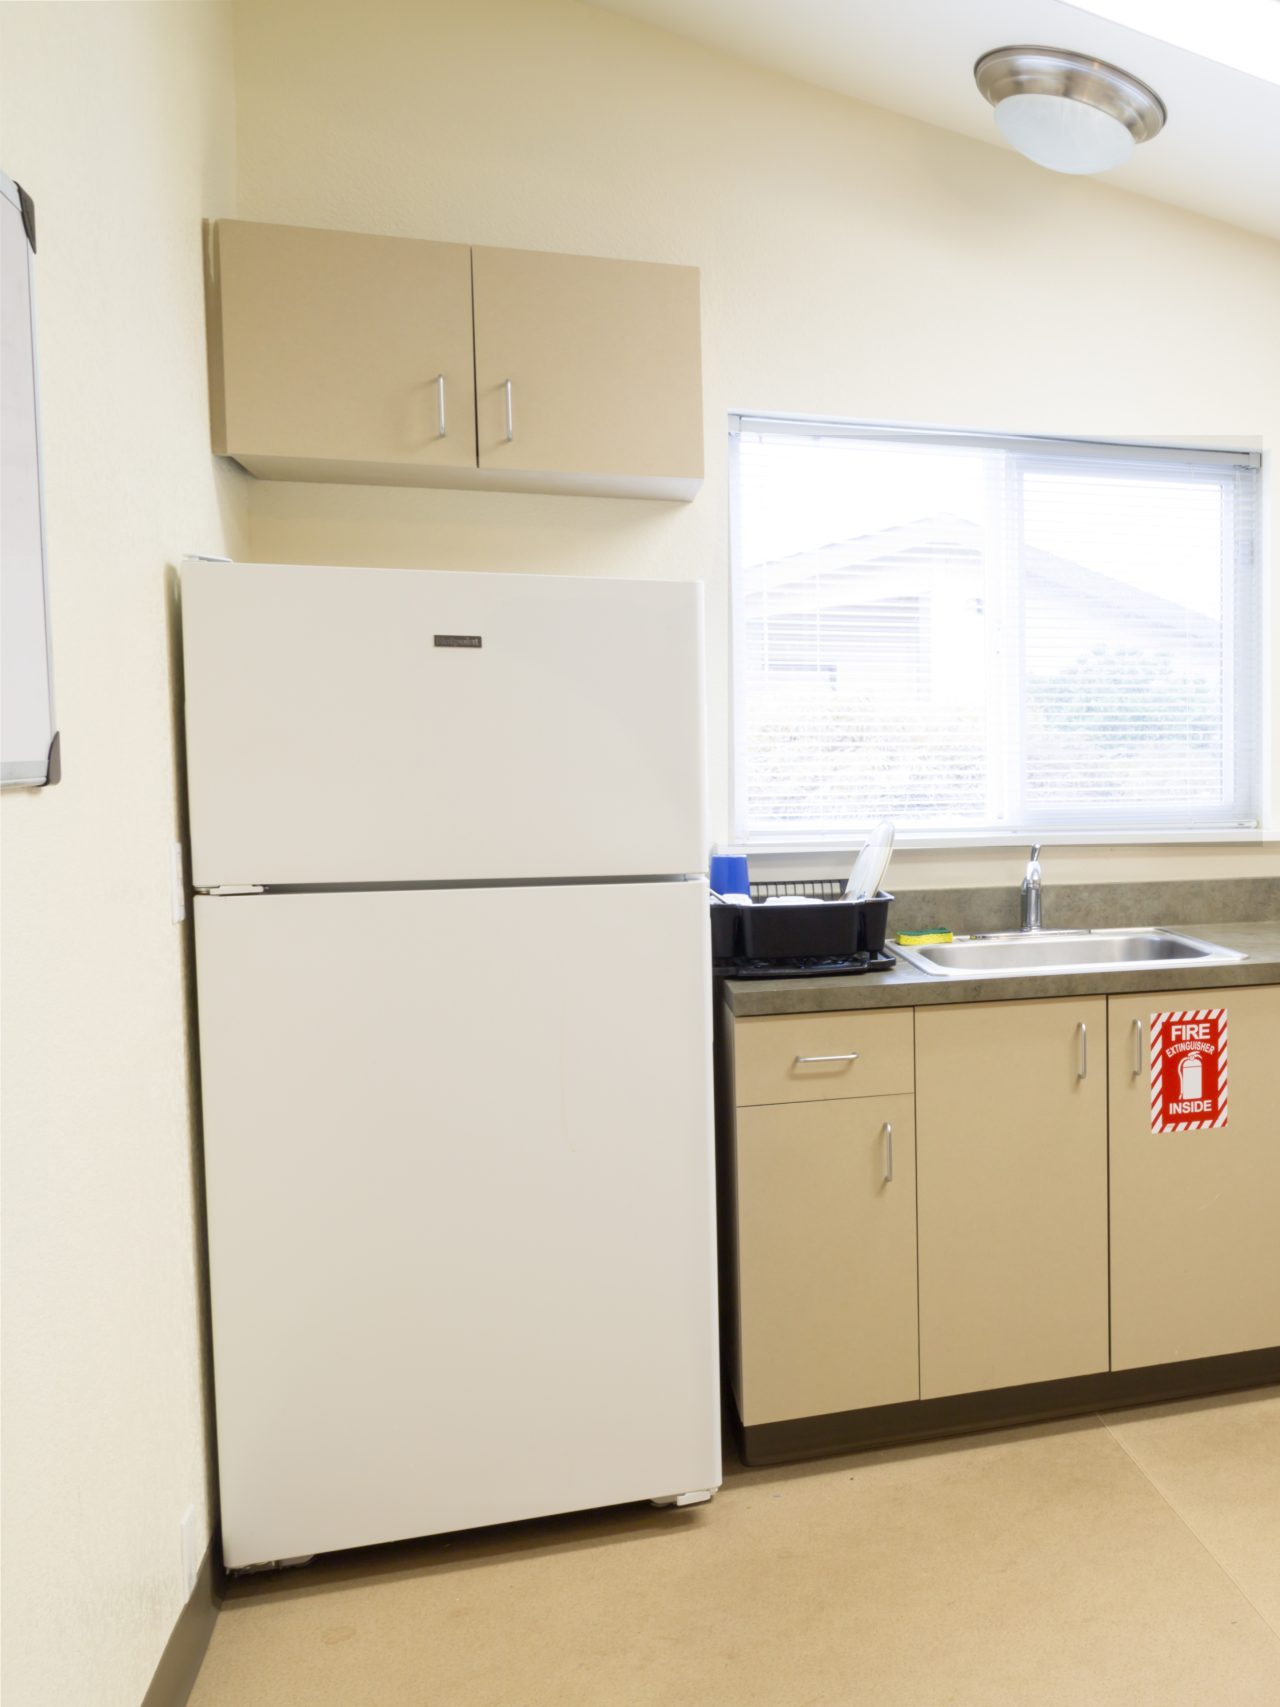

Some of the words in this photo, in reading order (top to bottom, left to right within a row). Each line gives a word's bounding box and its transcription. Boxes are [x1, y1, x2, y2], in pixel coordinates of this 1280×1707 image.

[1171, 1023, 1210, 1041] FIRE
[1165, 1041, 1215, 1058] EXTINGUISHER
[1169, 1100, 1212, 1115] INSIDE
